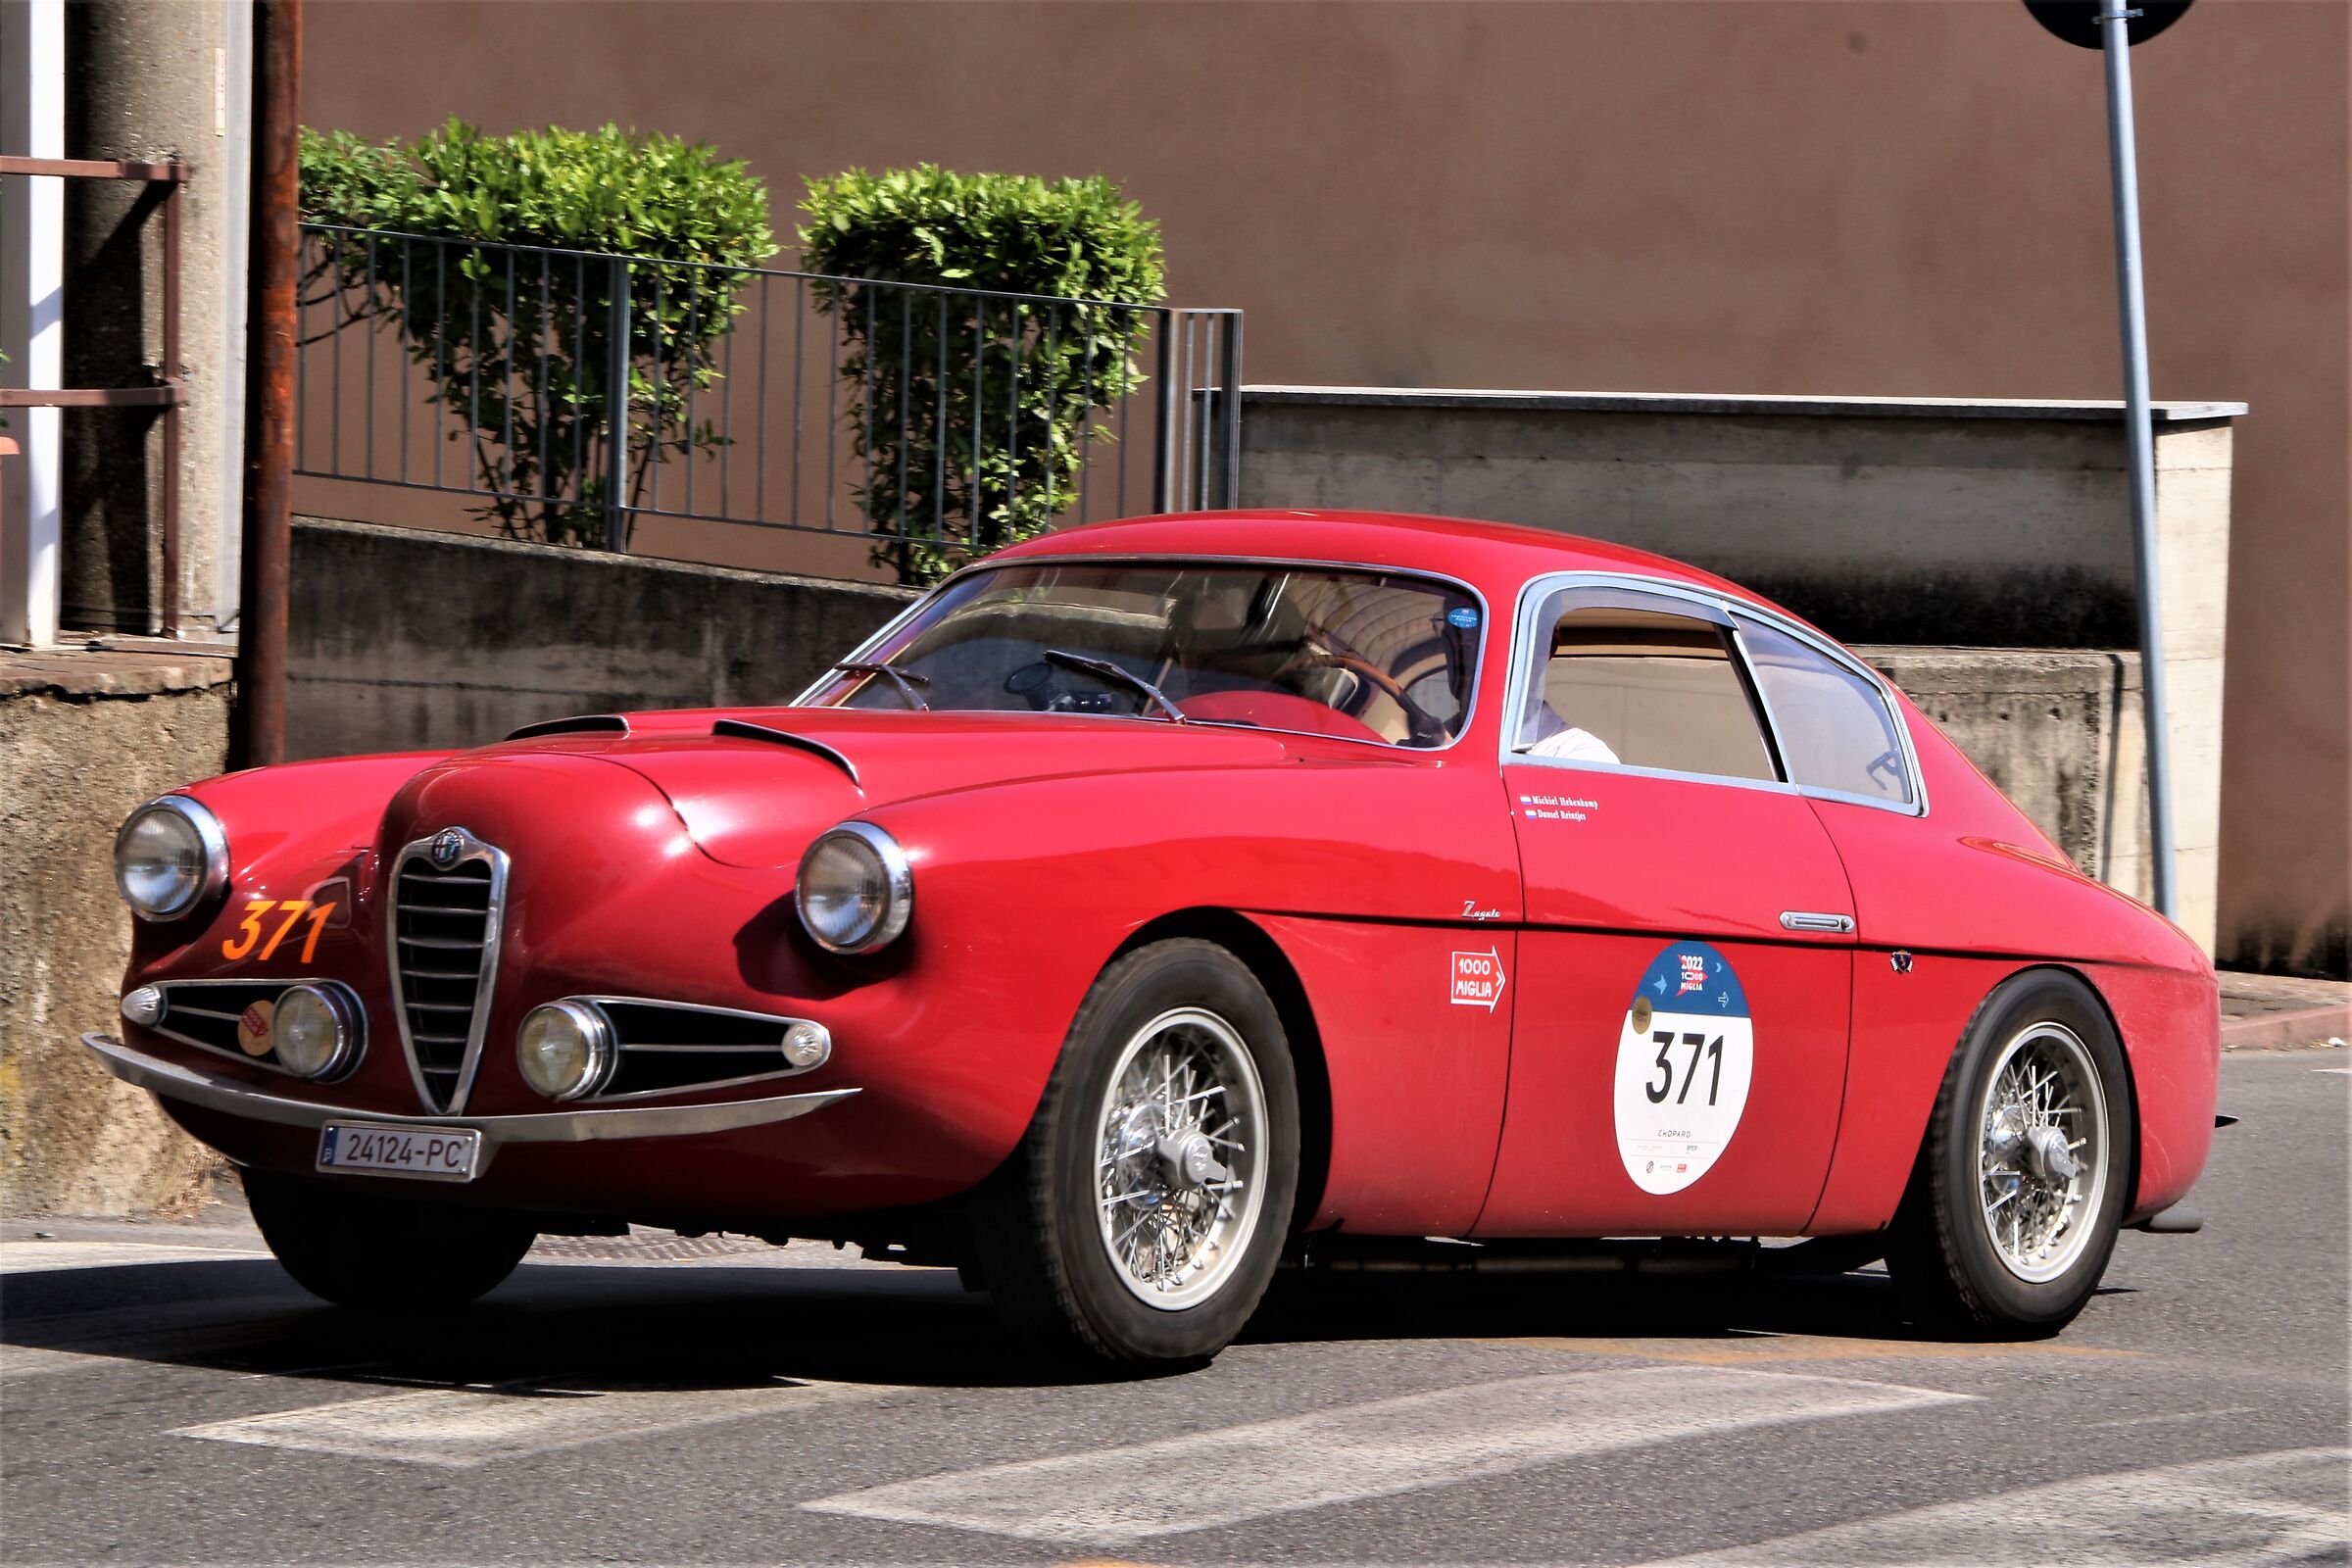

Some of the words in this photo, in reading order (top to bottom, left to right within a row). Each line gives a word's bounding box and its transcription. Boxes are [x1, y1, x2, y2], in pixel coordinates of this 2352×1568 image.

[1461, 900, 1500, 921] Zagato
[221, 900, 337, 964] 371
[1458, 957, 1491, 976] 1000
[1681, 955, 1703, 970] 2022
[1455, 980, 1493, 998] MIGLIA
[1680, 981, 1703, 991] MIGLIA
[1645, 1031, 1724, 1106] 371
[1657, 1129, 1691, 1139] CHOPARD
[346, 1134, 462, 1168] 24124-PC
